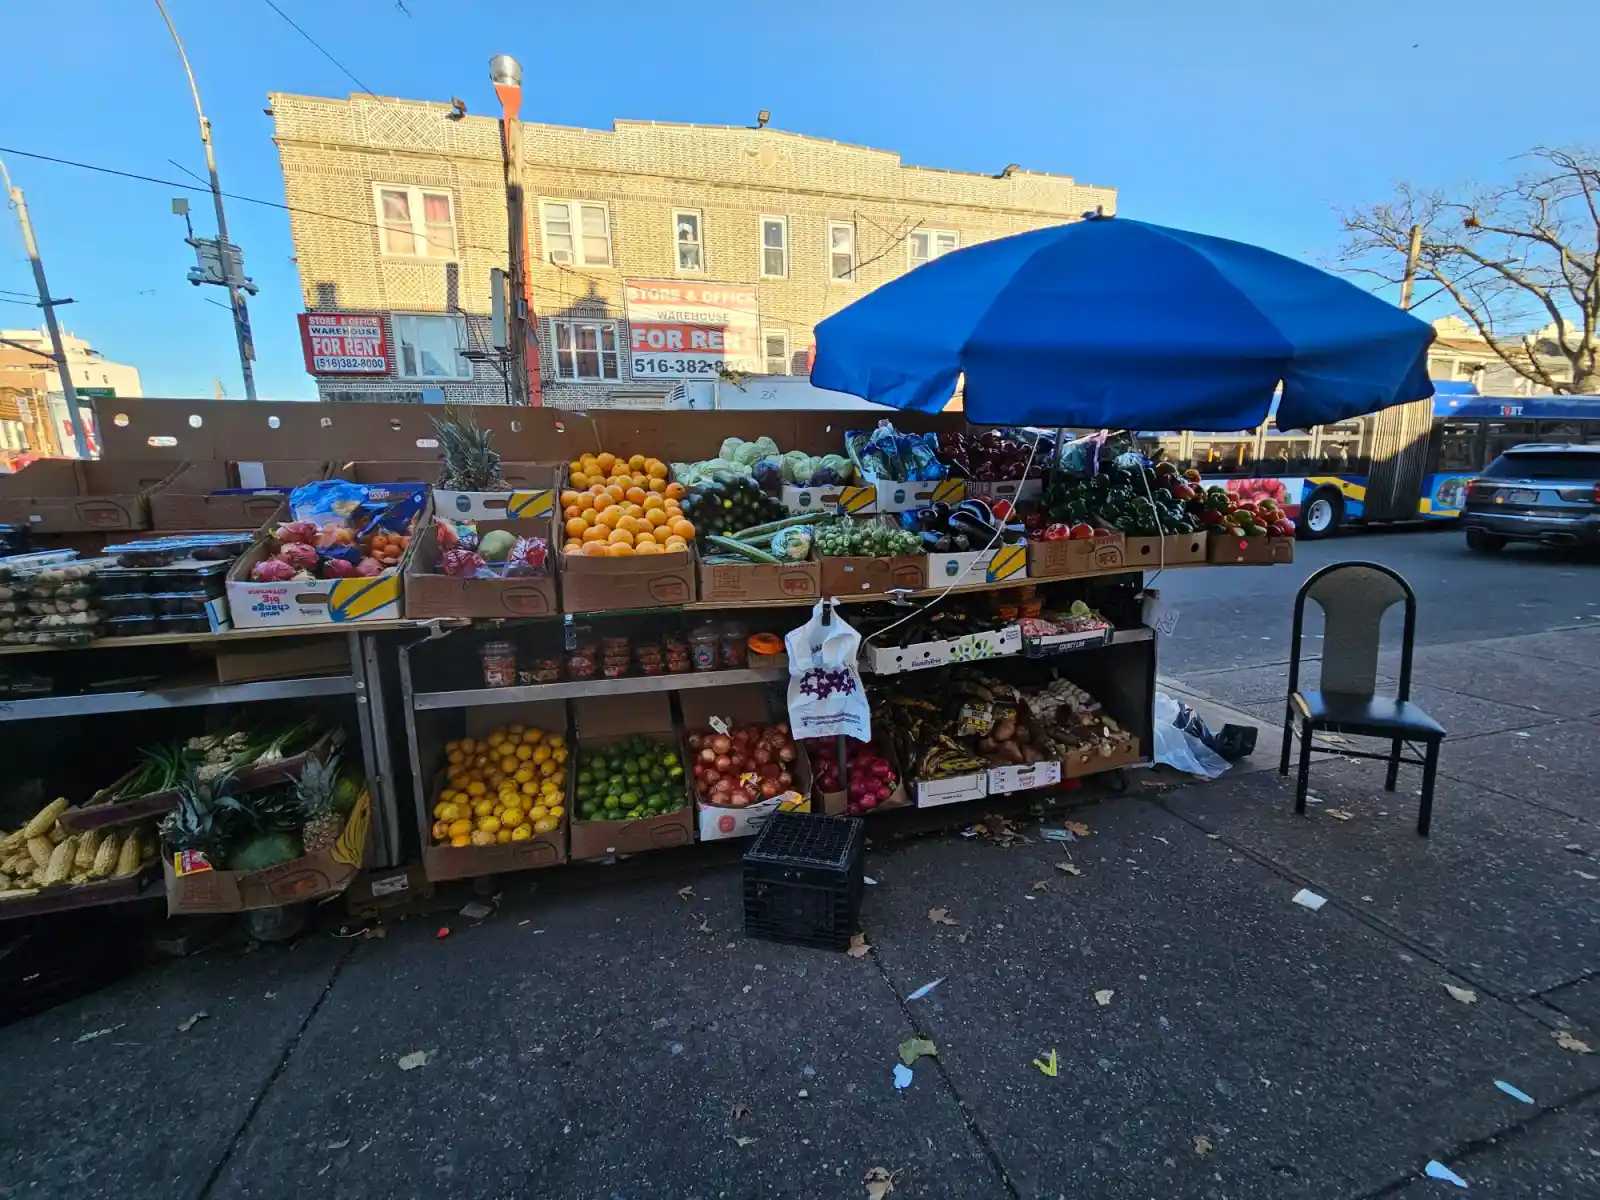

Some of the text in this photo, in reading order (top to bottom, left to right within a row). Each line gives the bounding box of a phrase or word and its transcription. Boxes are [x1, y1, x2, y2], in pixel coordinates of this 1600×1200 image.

[309, 316, 336, 326] STORE
[348, 317, 378, 327] OFFICE
[656, 311, 729, 321] WAREHOUSE
[311, 327, 378, 336] WAREHOUSE
[631, 328, 685, 349] FOR
[312, 337, 381, 357] FOR RENT
[315, 358, 384, 370] (516)382-8000
